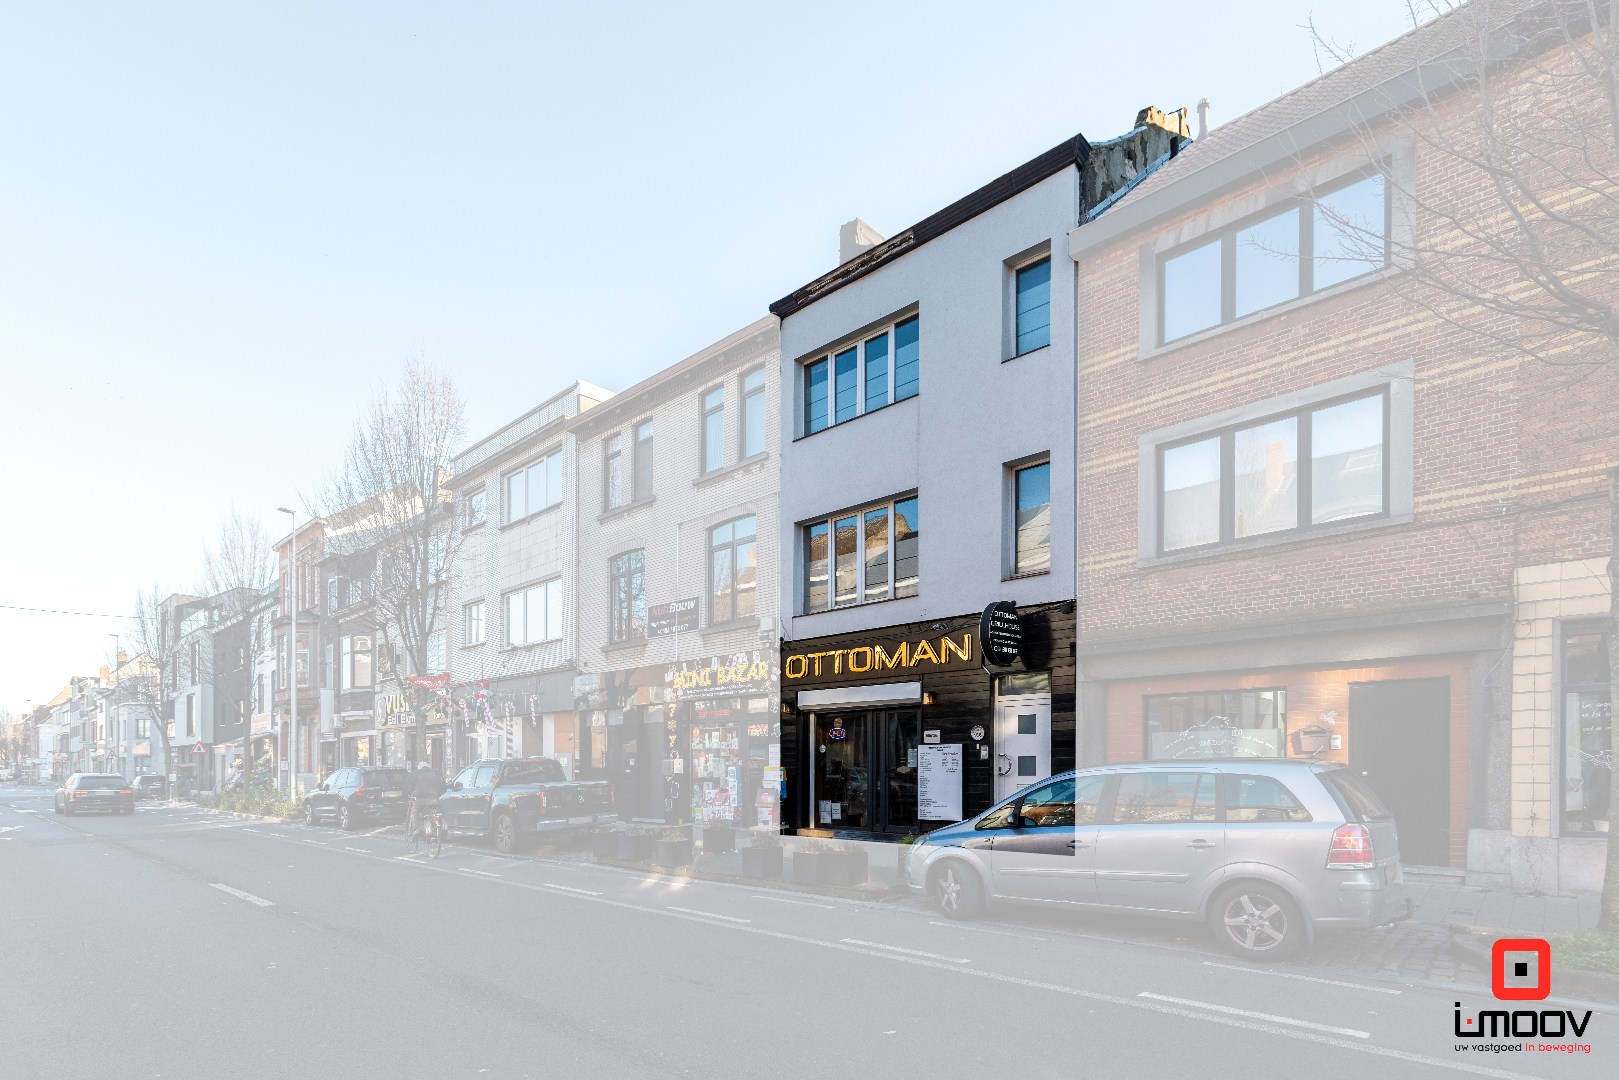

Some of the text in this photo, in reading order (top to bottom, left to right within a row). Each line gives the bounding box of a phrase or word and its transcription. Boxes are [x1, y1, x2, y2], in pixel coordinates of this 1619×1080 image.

[673, 667, 712, 689] MINI
[717, 660, 769, 685] BAZAR
[785, 633, 973, 679] OTTOMAN
